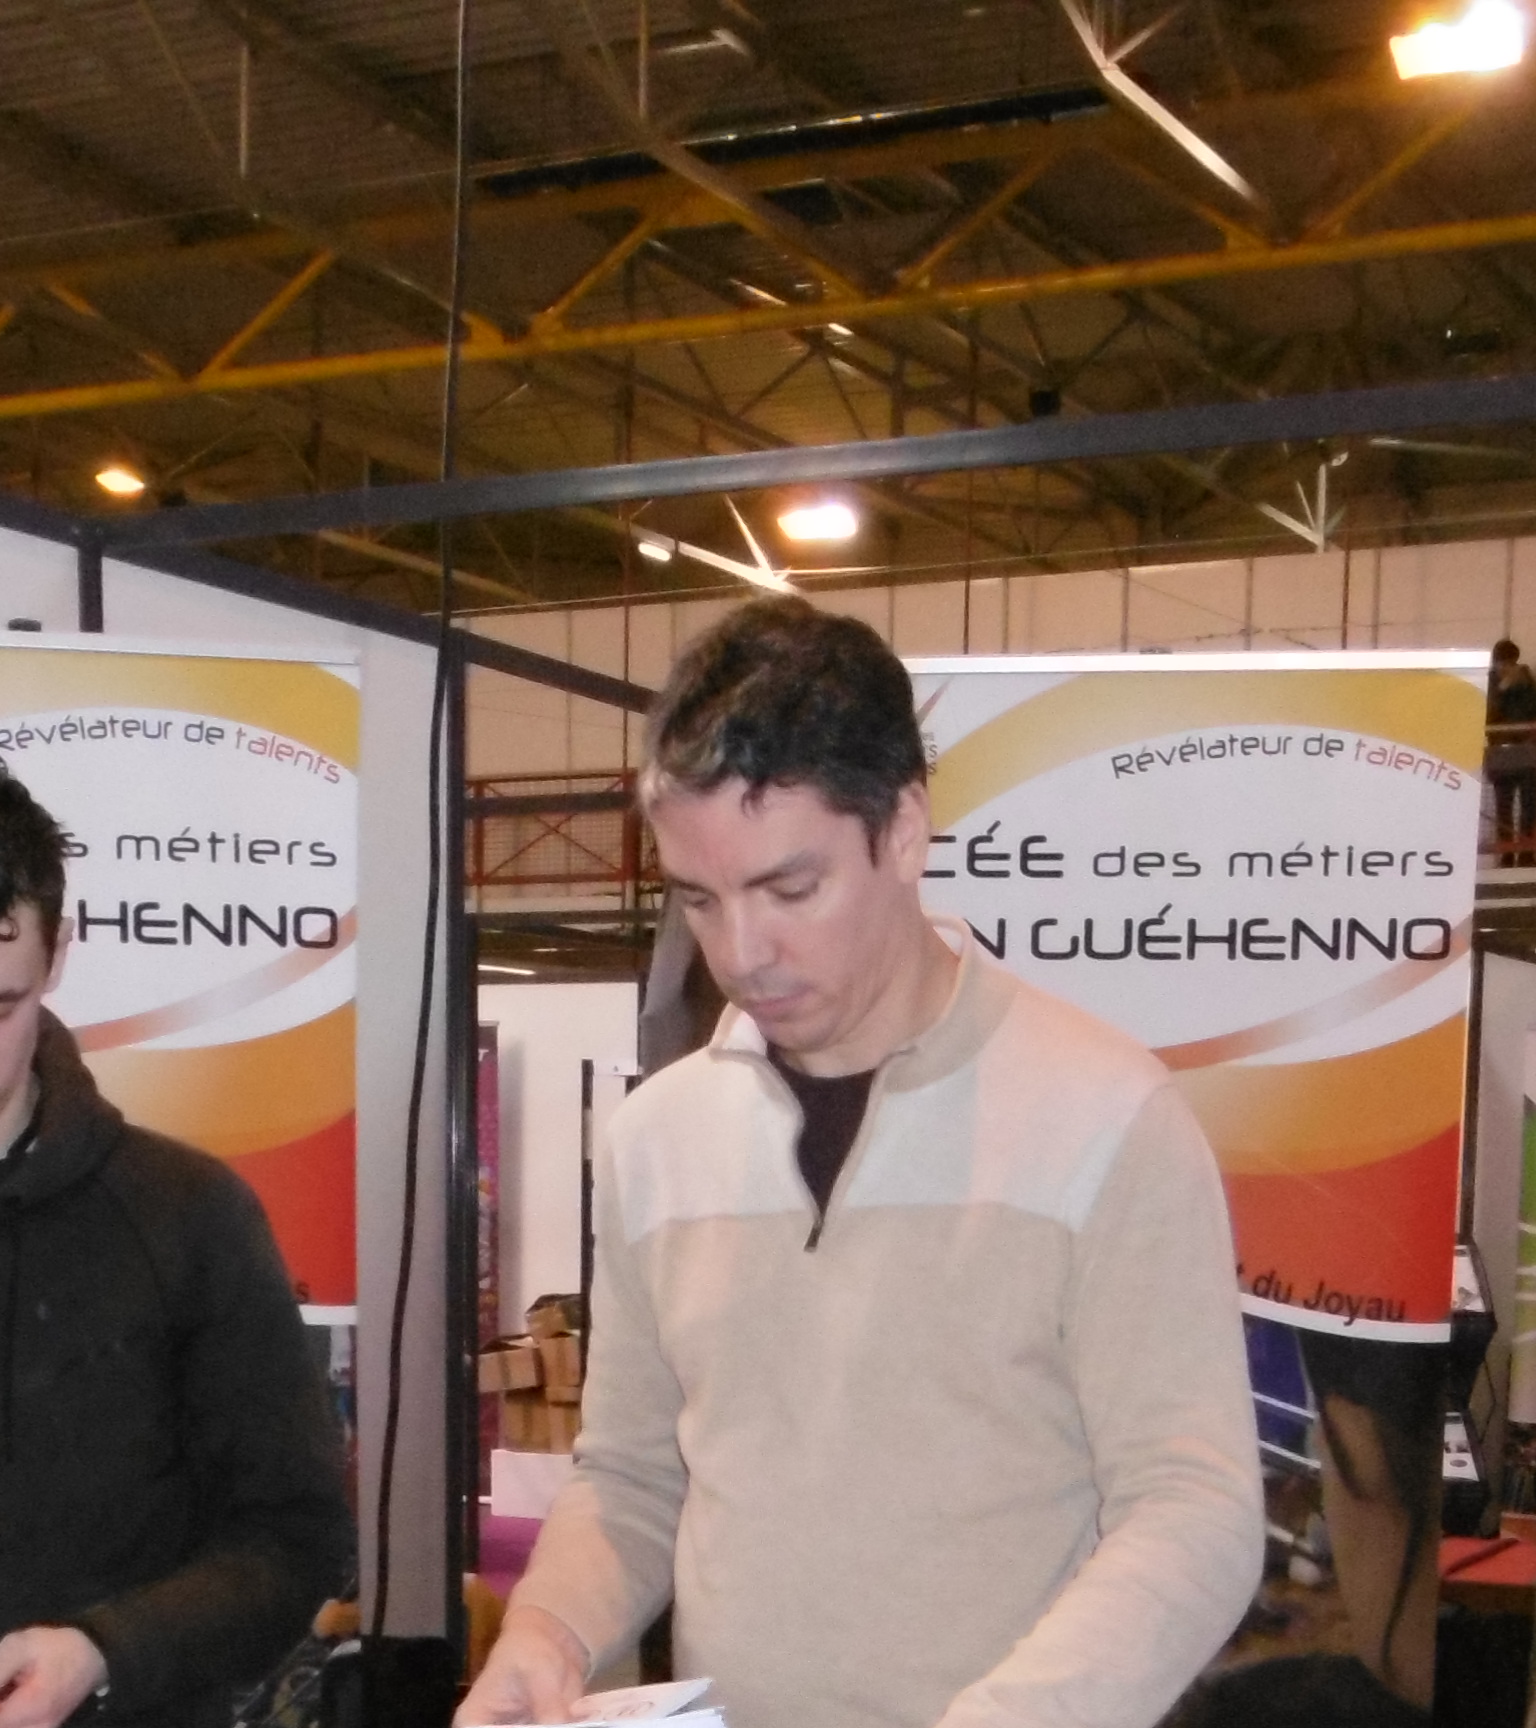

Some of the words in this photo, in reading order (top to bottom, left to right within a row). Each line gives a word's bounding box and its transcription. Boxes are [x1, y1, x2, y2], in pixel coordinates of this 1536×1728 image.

[183, 720, 225, 746] de
[234, 726, 341, 785] talents
[1110, 732, 1294, 779] Révélateur
[1302, 732, 1345, 759] de
[1353, 738, 1462, 792] talents
[115, 826, 338, 868] métiers
[920, 819, 1065, 879] CÉE
[1092, 845, 1202, 878] des
[1227, 840, 1455, 878] métiers
[76, 898, 339, 950] HENNO
[1030, 902, 1453, 962] GUÉHENNO
[1251, 1269, 1293, 1305] du
[1302, 1280, 1407, 1327] Joyau
